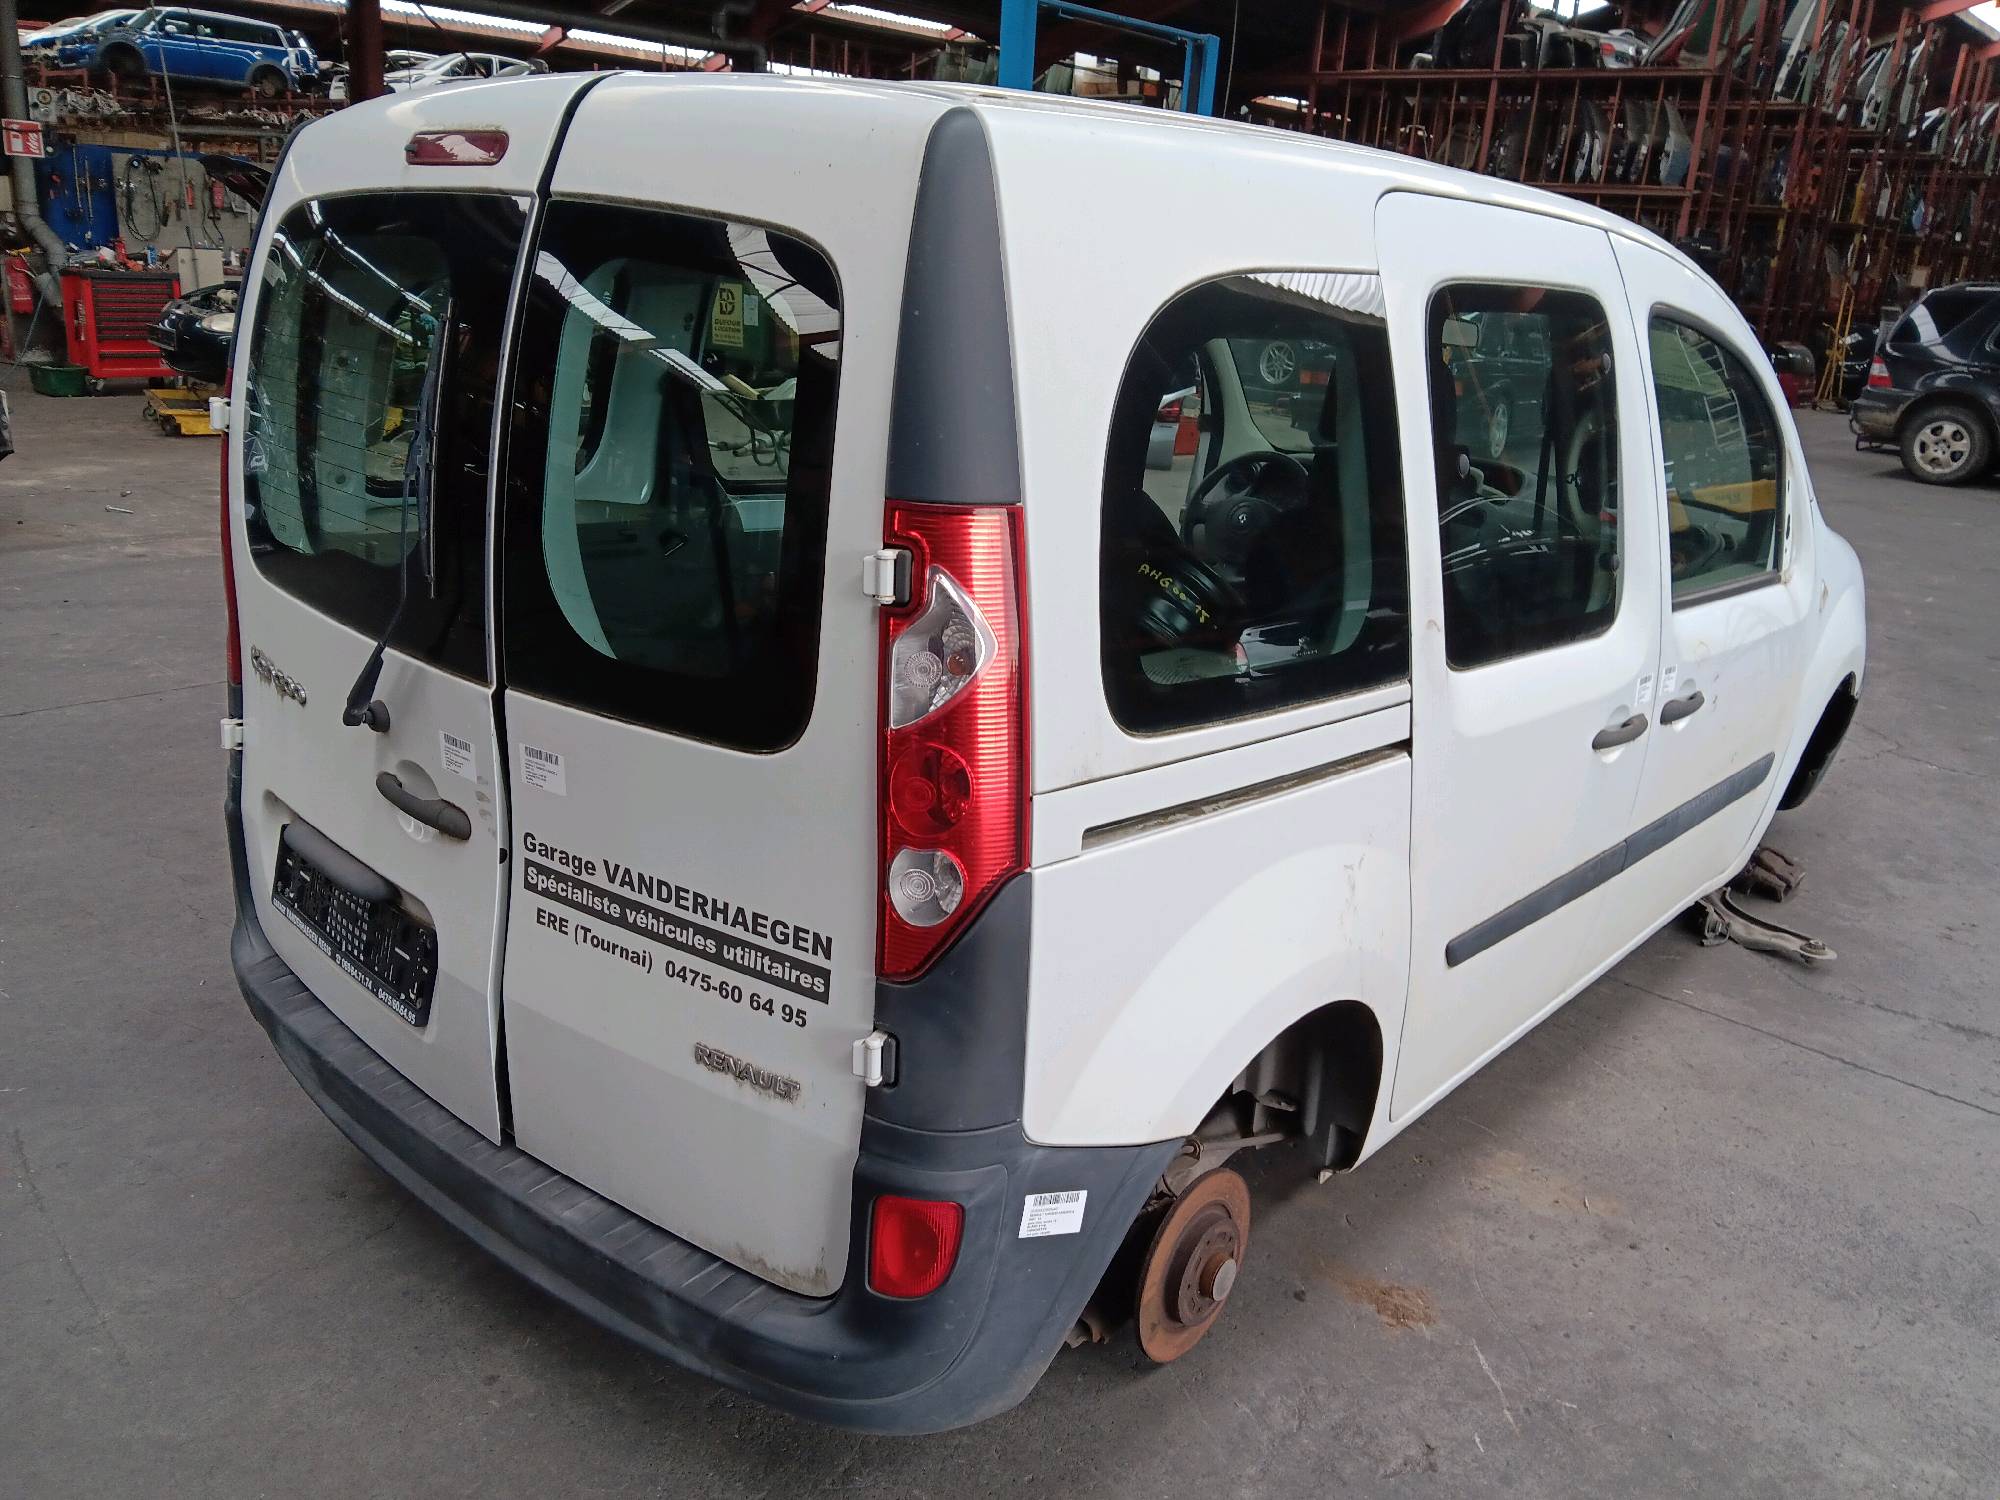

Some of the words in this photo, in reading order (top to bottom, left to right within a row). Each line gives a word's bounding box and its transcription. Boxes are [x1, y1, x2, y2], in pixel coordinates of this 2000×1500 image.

[523, 831, 597, 876] Garage
[603, 858, 833, 961] VANDERHAEGEN
[526, 866, 621, 918] Spécialiste
[625, 908, 717, 954] véhicules
[723, 944, 825, 993] utilitaires
[536, 906, 569, 935] ERE
[574, 923, 653, 974] (Tournai)
[665, 960, 743, 1003] 0475-60
[750, 992, 775, 1016] 64
[781, 1003, 807, 1027] 95
[694, 1042, 801, 1104] RENAULT
